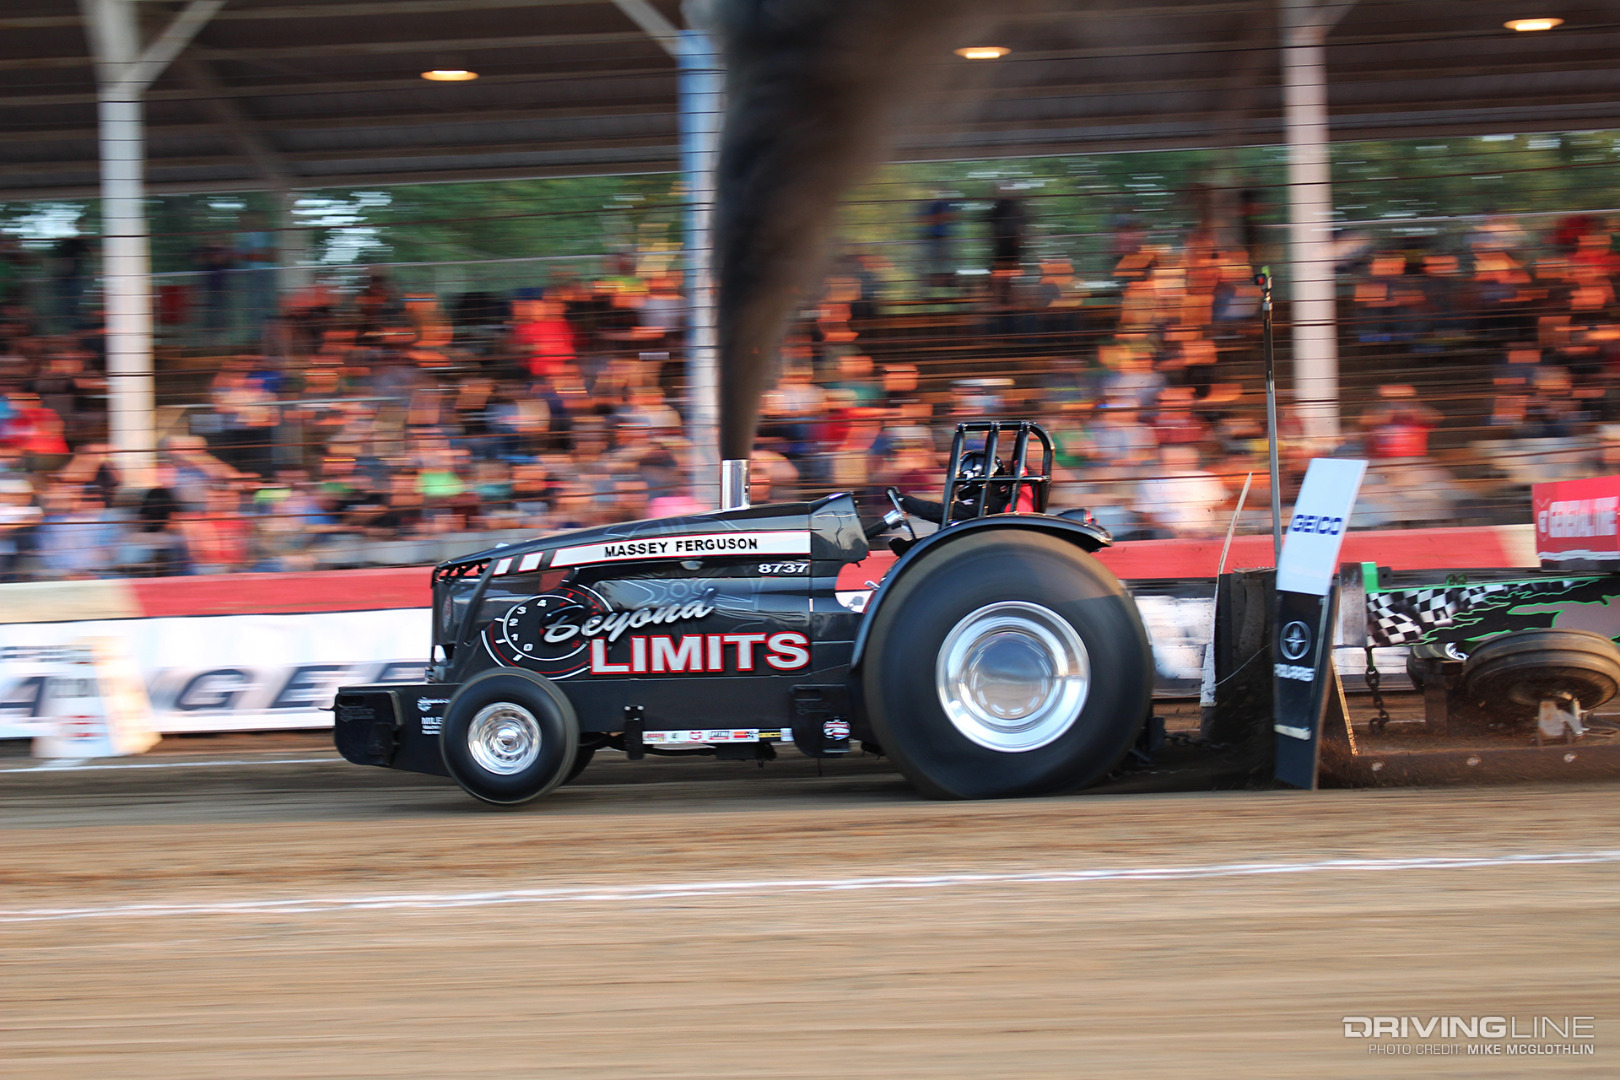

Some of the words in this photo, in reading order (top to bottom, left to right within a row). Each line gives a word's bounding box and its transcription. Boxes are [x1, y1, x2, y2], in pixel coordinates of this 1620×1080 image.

[1291, 514, 1342, 535] GEICO
[604, 541, 668, 558] MASSEY
[676, 537, 758, 552] FERGUSON
[758, 563, 810, 574] 8737
[543, 587, 716, 643] Beyond
[589, 631, 811, 675] LIMITS
